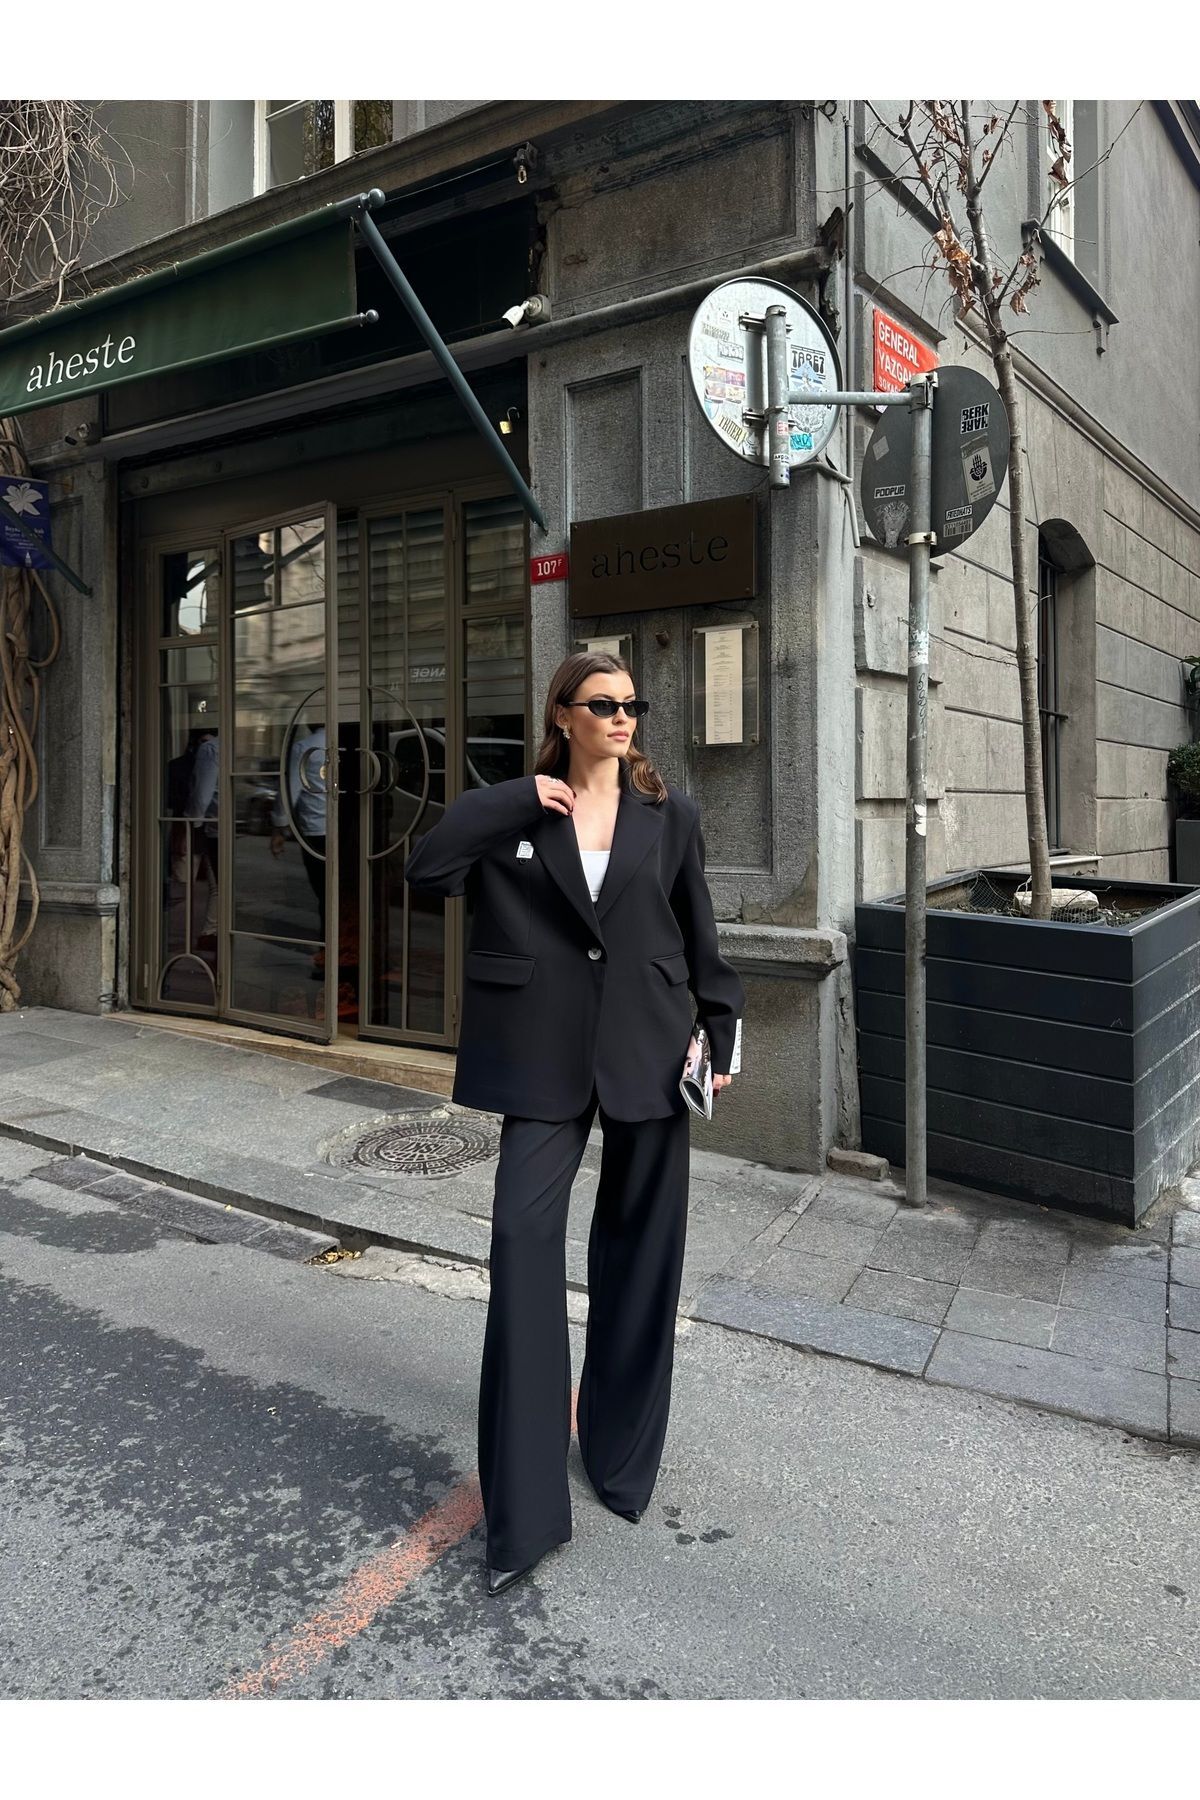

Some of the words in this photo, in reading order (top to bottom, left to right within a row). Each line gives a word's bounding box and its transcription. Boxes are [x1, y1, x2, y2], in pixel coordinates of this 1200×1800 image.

[26, 333, 136, 392] aheste
[878, 320, 920, 368] GENERAL
[591, 529, 729, 578] aheste
